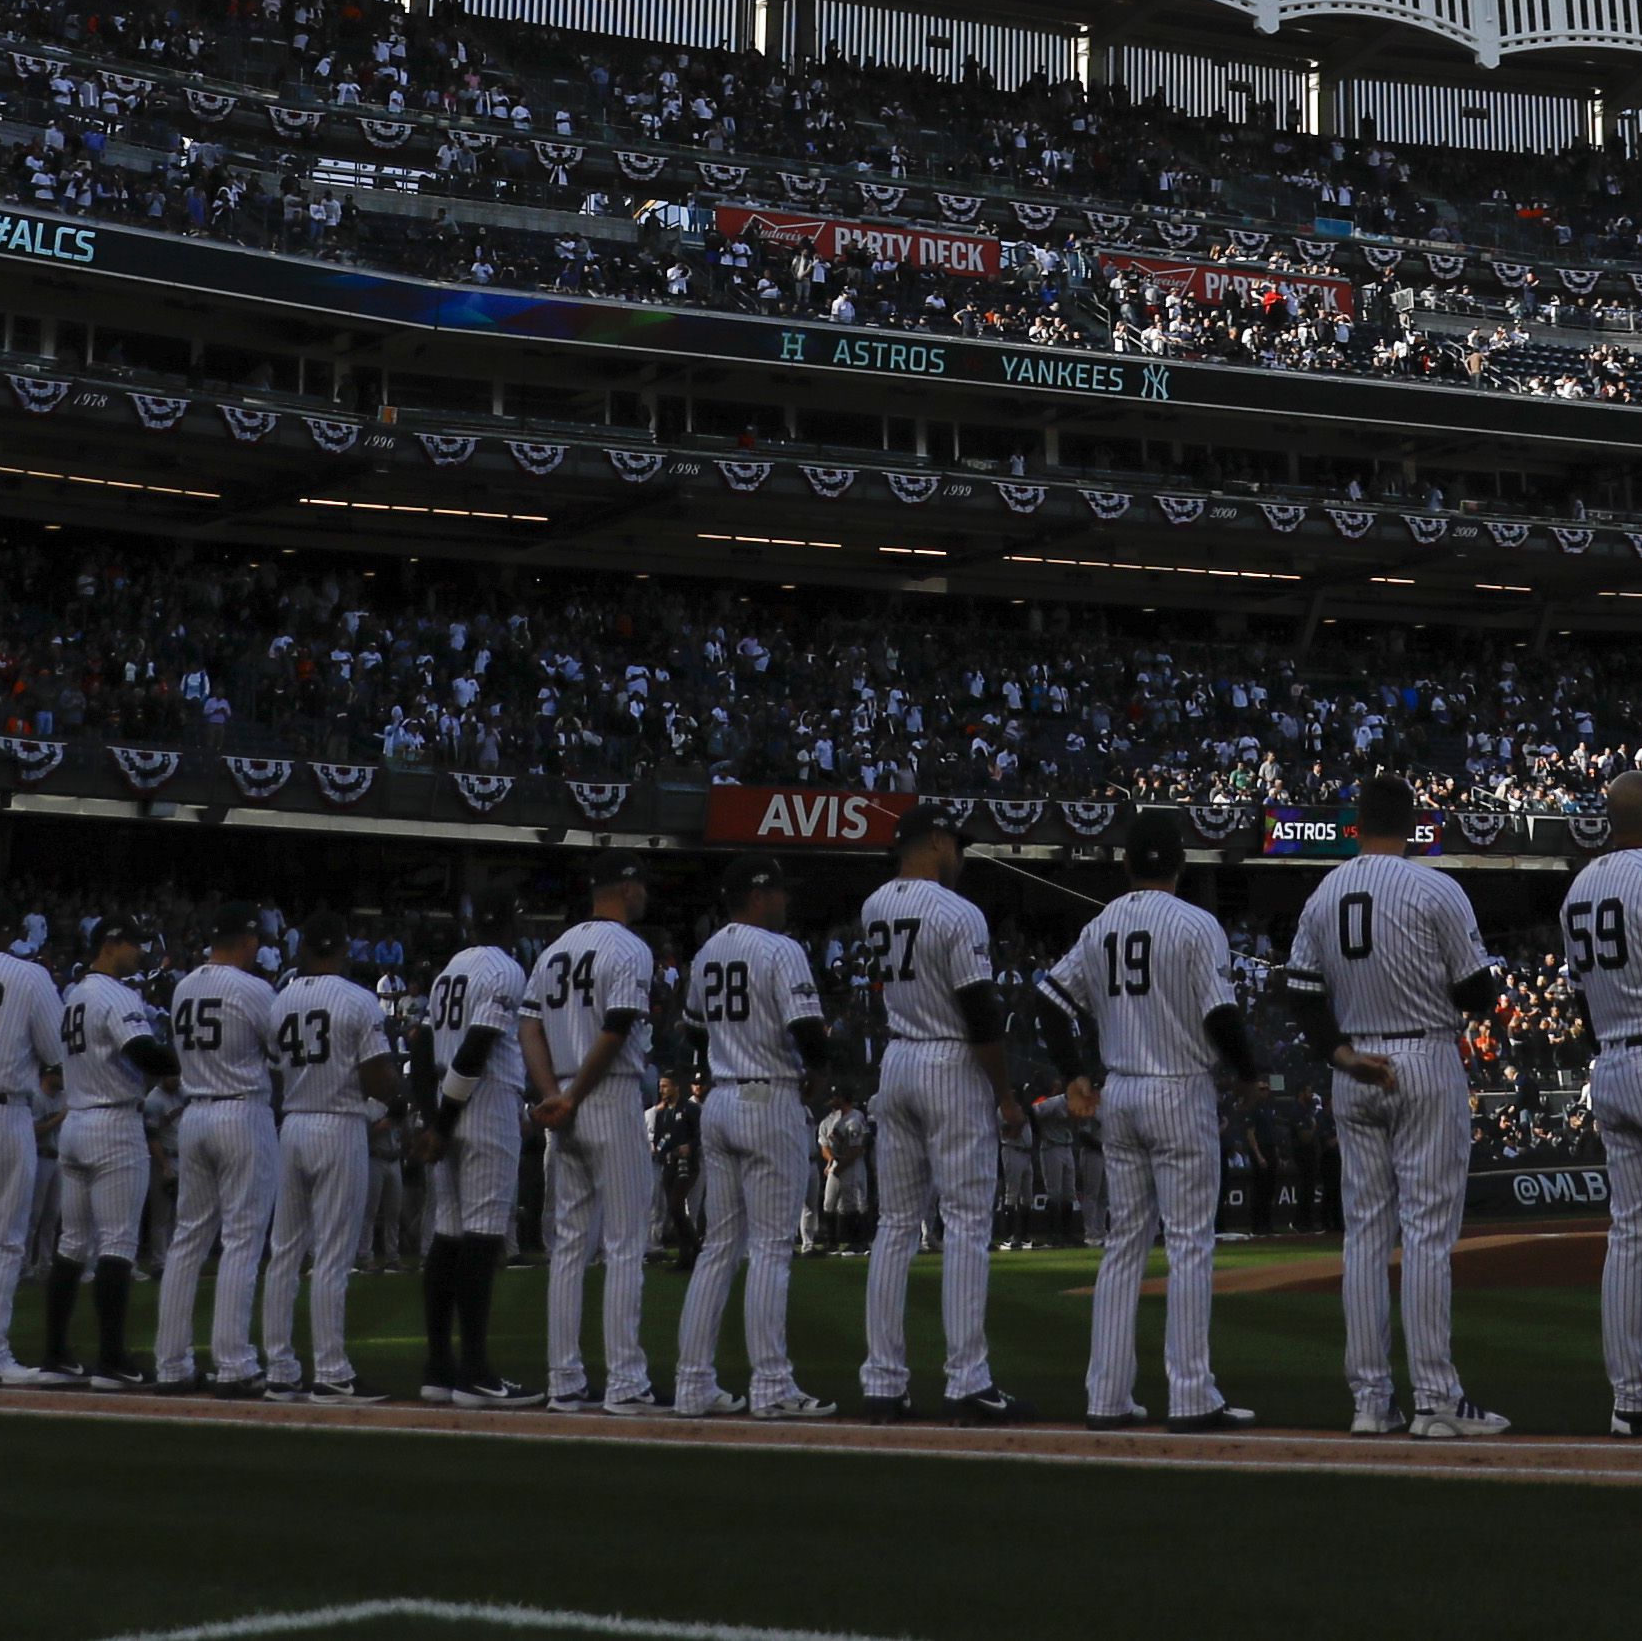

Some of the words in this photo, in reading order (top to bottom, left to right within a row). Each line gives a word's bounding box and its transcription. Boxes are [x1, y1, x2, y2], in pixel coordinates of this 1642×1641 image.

[834, 226, 913, 263] PARTY
[919, 237, 985, 272] DECK
[832, 338, 946, 374] ASTROS
[1001, 355, 1125, 392] YANKEES
[72, 392, 109, 408] 1978
[363, 433, 396, 450] 1996
[667, 461, 701, 476] 1998
[942, 484, 973, 498] 1999
[1209, 506, 1238, 520] 2000
[1451, 526, 1479, 539] 2009
[756, 793, 868, 840] AVIS
[1271, 821, 1337, 841] ASTROS
[867, 917, 922, 983] 27
[1338, 890, 1373, 961] 0
[1566, 896, 1630, 973] 59
[546, 949, 597, 1010] 34
[1103, 929, 1152, 998] 19
[433, 973, 470, 1031] 38
[704, 961, 751, 1022] 28
[60, 1002, 87, 1056] 48
[174, 997, 223, 1051] 45
[277, 1008, 331, 1068] 43
[1278, 1185, 1324, 1205] ALS
